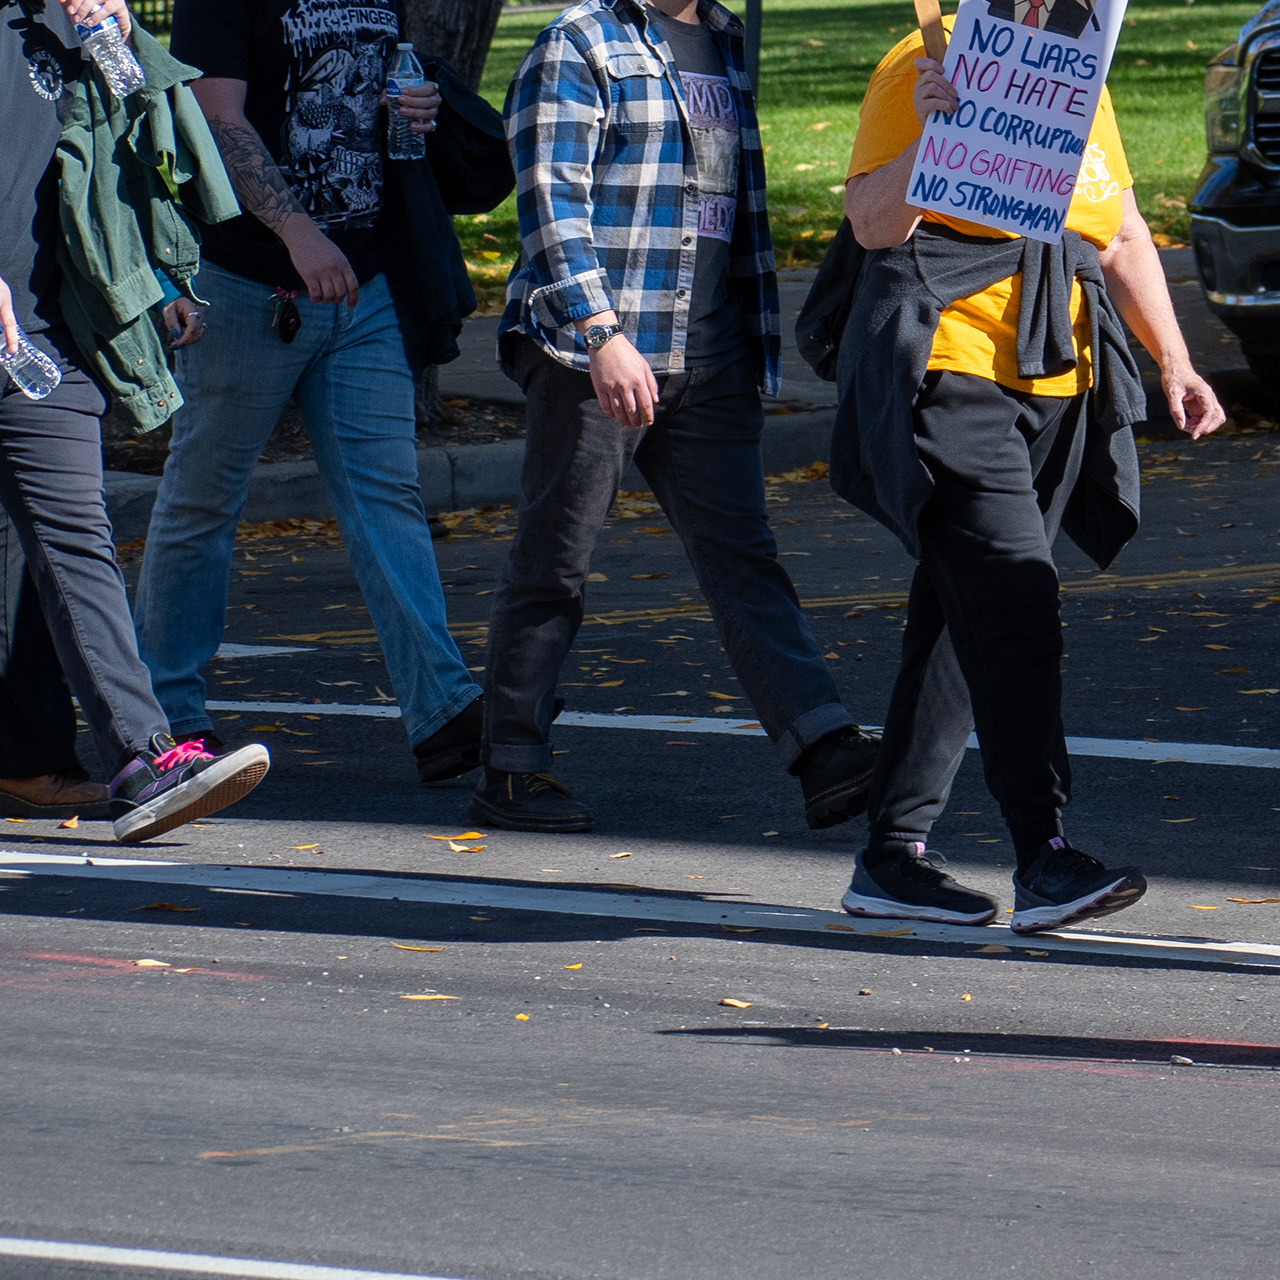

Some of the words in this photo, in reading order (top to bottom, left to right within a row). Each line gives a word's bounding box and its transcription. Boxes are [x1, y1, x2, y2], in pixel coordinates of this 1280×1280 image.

[346, 9, 398, 29] FINGERS
[969, 18, 1014, 57] NO
[1020, 35, 1098, 80] LIARS
[951, 53, 1001, 92] NO
[1003, 68, 1088, 118] HATE
[922, 136, 968, 169] NO
[970, 149, 1076, 196] GRIFTING
[912, 172, 948, 202] NO
[949, 181, 1066, 233] STRONGMAN
